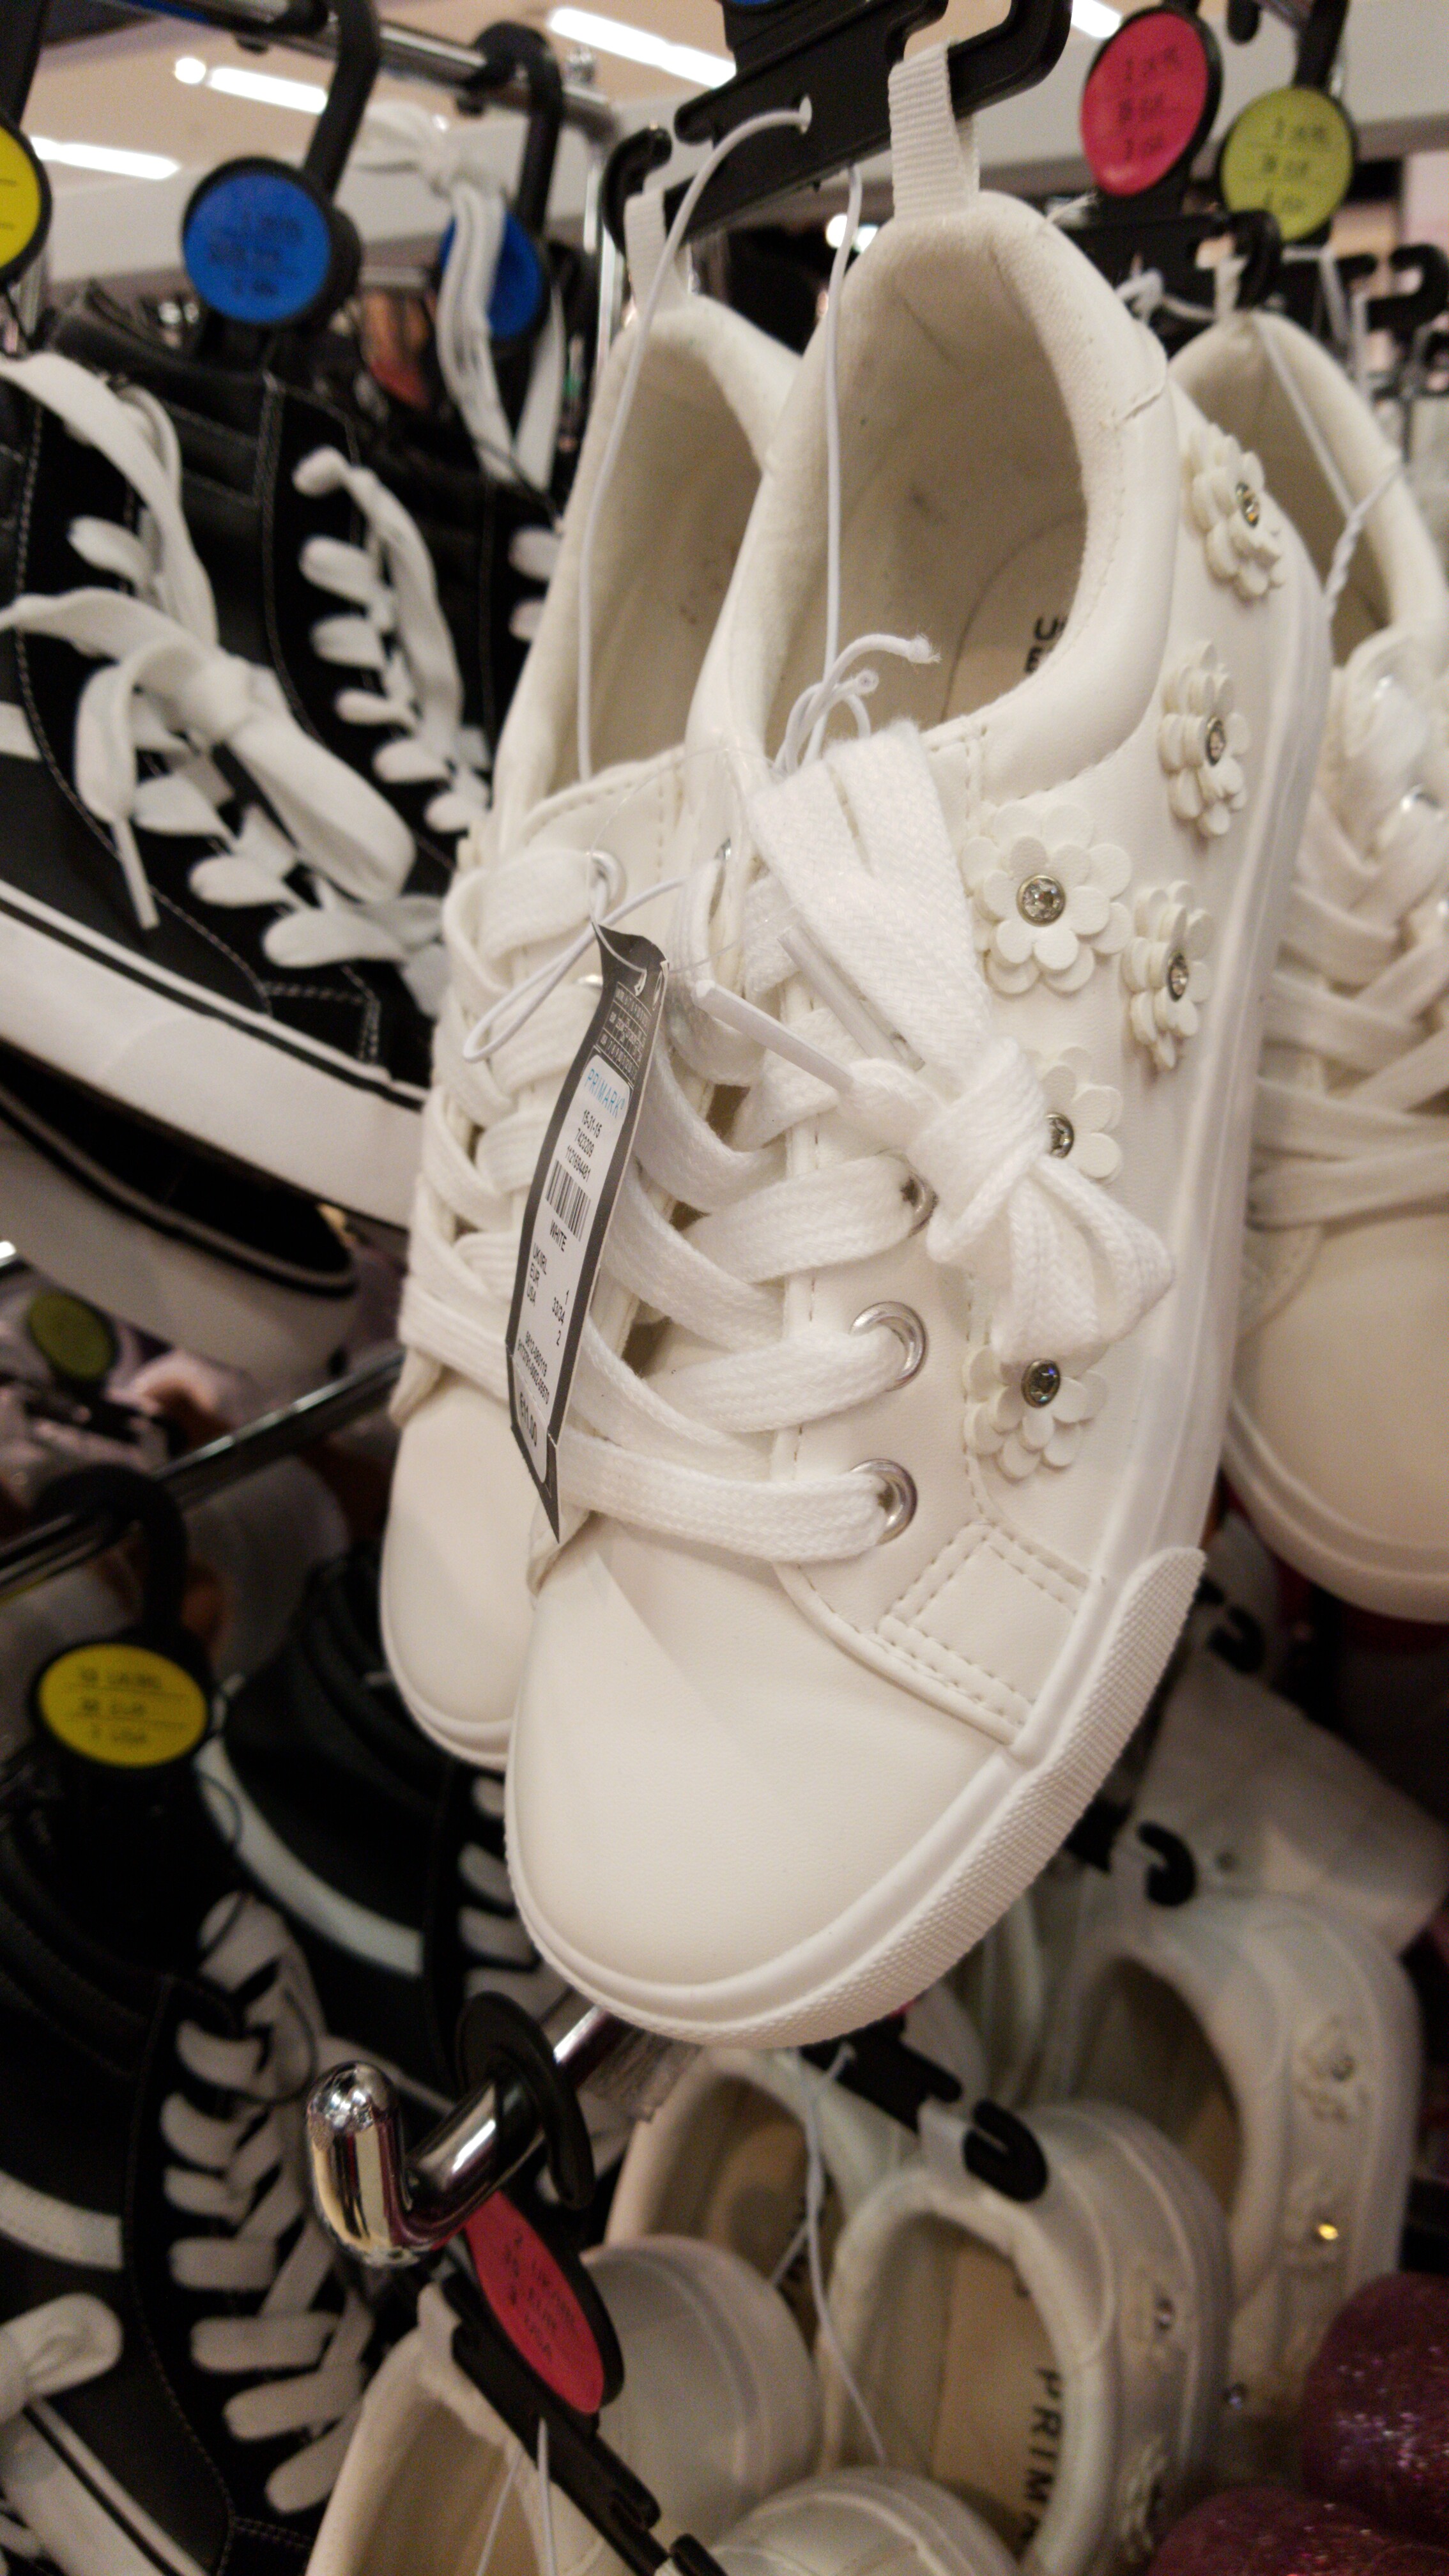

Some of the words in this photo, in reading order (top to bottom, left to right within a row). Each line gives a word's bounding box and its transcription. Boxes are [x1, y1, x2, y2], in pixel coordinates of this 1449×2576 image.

[581, 1109, 602, 1138] 15-31-15
[574, 1128, 595, 1158] 7423209
[549, 1220, 567, 1252] WHITE
[530, 1262, 540, 1288] EUR
[565, 1290, 569, 1305] 1
[526, 1281, 536, 1307] USA
[556, 1330, 561, 1346] 2
